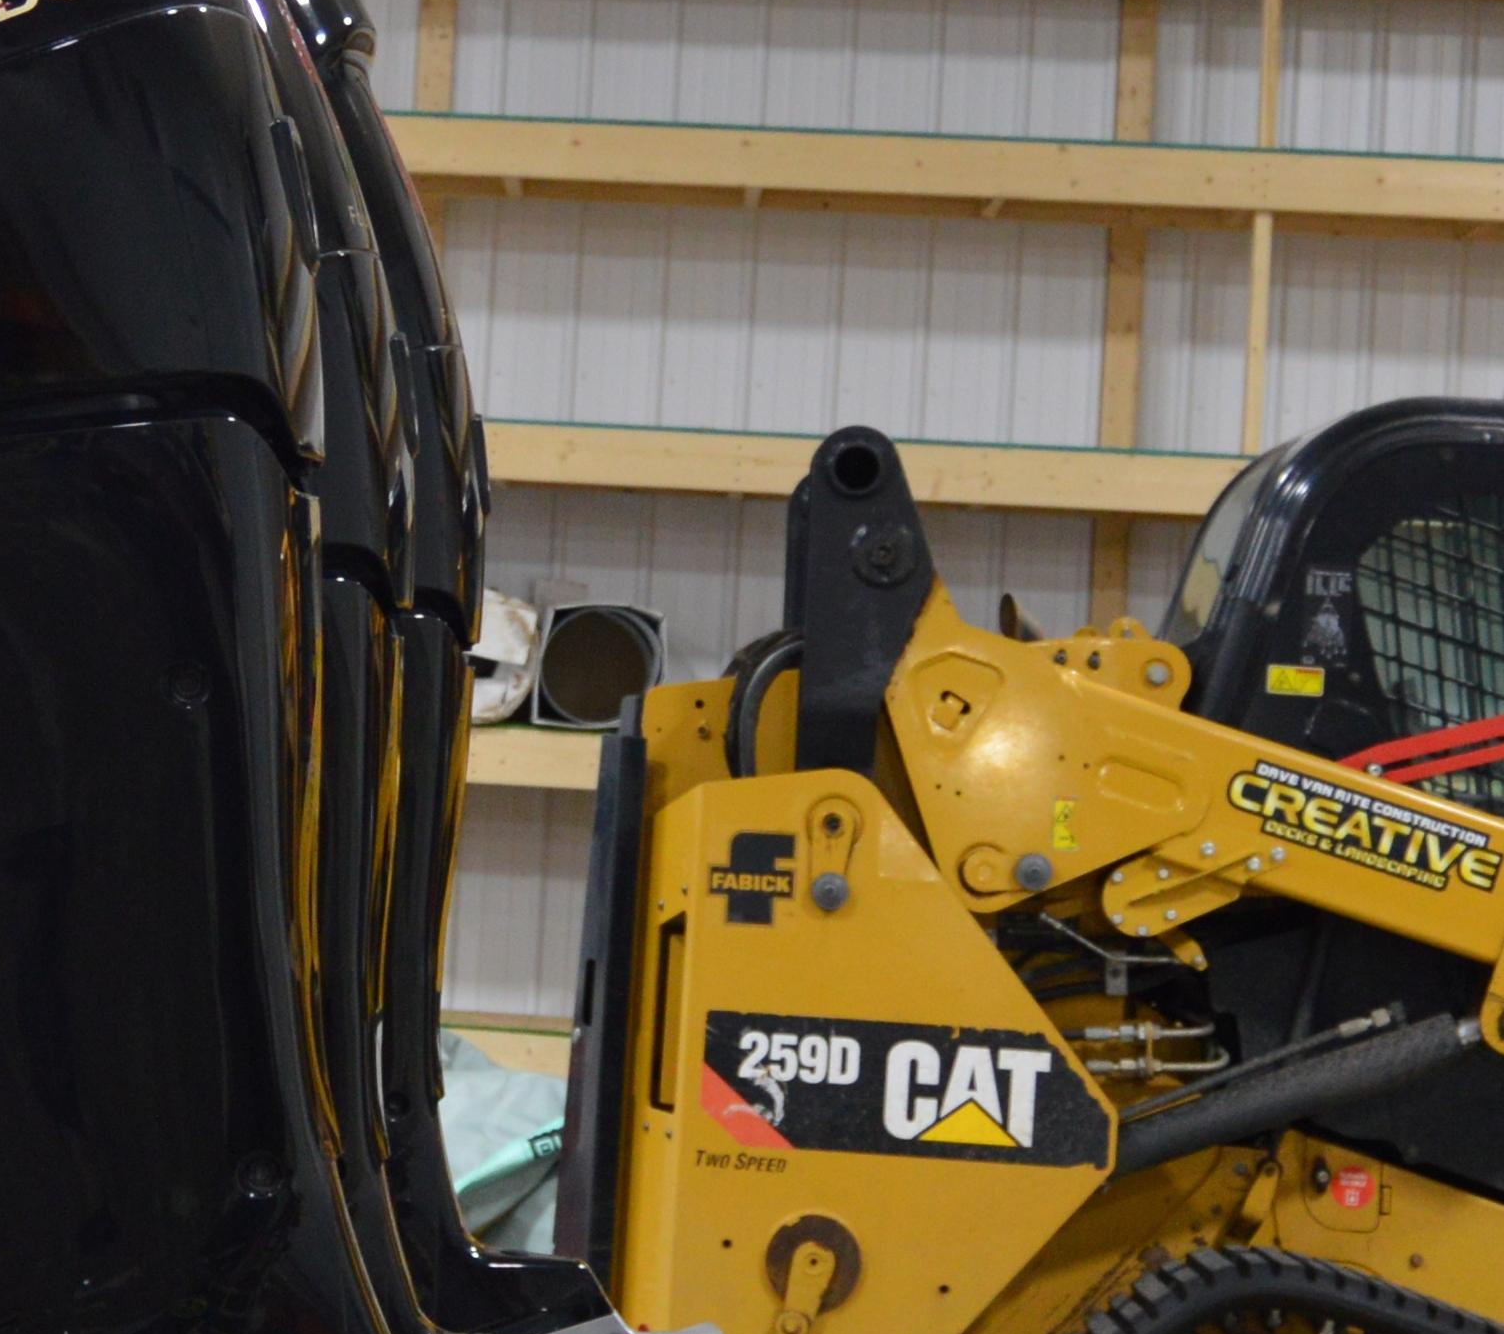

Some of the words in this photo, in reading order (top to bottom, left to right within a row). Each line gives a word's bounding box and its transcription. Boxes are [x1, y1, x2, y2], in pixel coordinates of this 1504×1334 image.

[1228, 771, 1501, 890] CREATIVE
[1256, 761, 1302, 787] DAVE
[1301, 774, 1334, 798] VAN
[1333, 783, 1372, 810] RITE
[1371, 797, 1488, 848] CONSTRUCTION
[1264, 820, 1318, 846] DECKS
[1318, 835, 1333, 851] &
[711, 871, 791, 893] FABICK
[737, 1030, 862, 1086] 259D
[882, 1039, 1053, 1148] CAT
